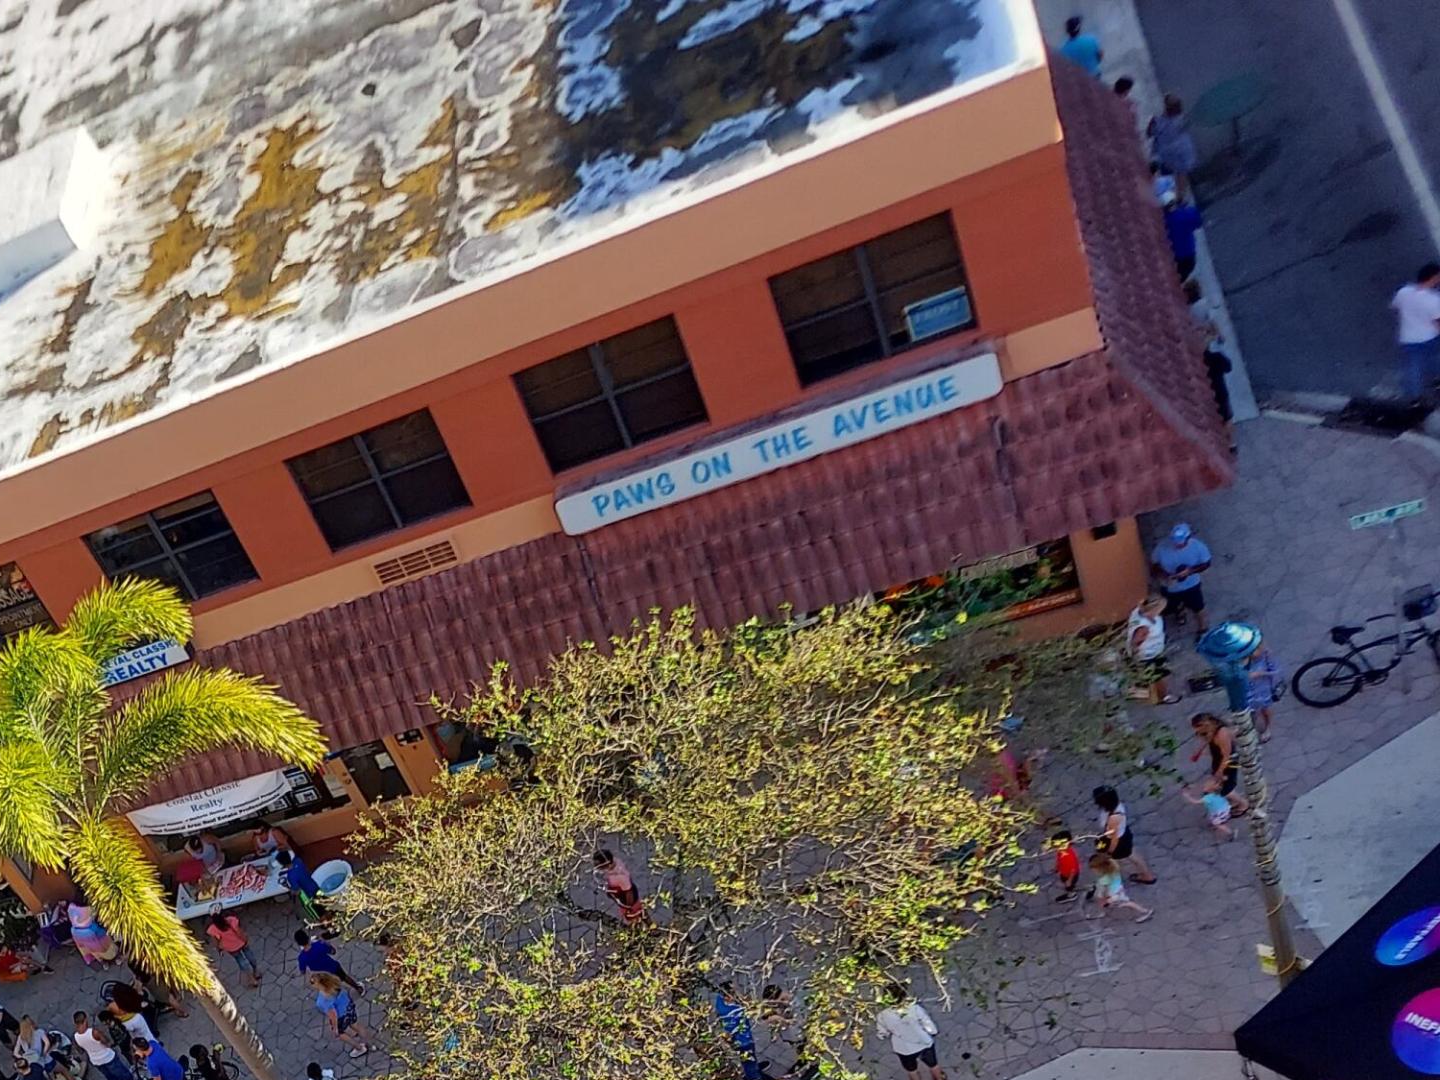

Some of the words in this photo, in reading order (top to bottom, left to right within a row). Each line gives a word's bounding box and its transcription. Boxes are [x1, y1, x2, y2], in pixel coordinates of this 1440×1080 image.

[592, 473, 676, 517] PAWS
[691, 451, 732, 485] ON
[752, 427, 813, 462] THE
[833, 376, 959, 438] AVENUE
[104, 652, 169, 684] REALTY
[189, 796, 224, 813] Realty
